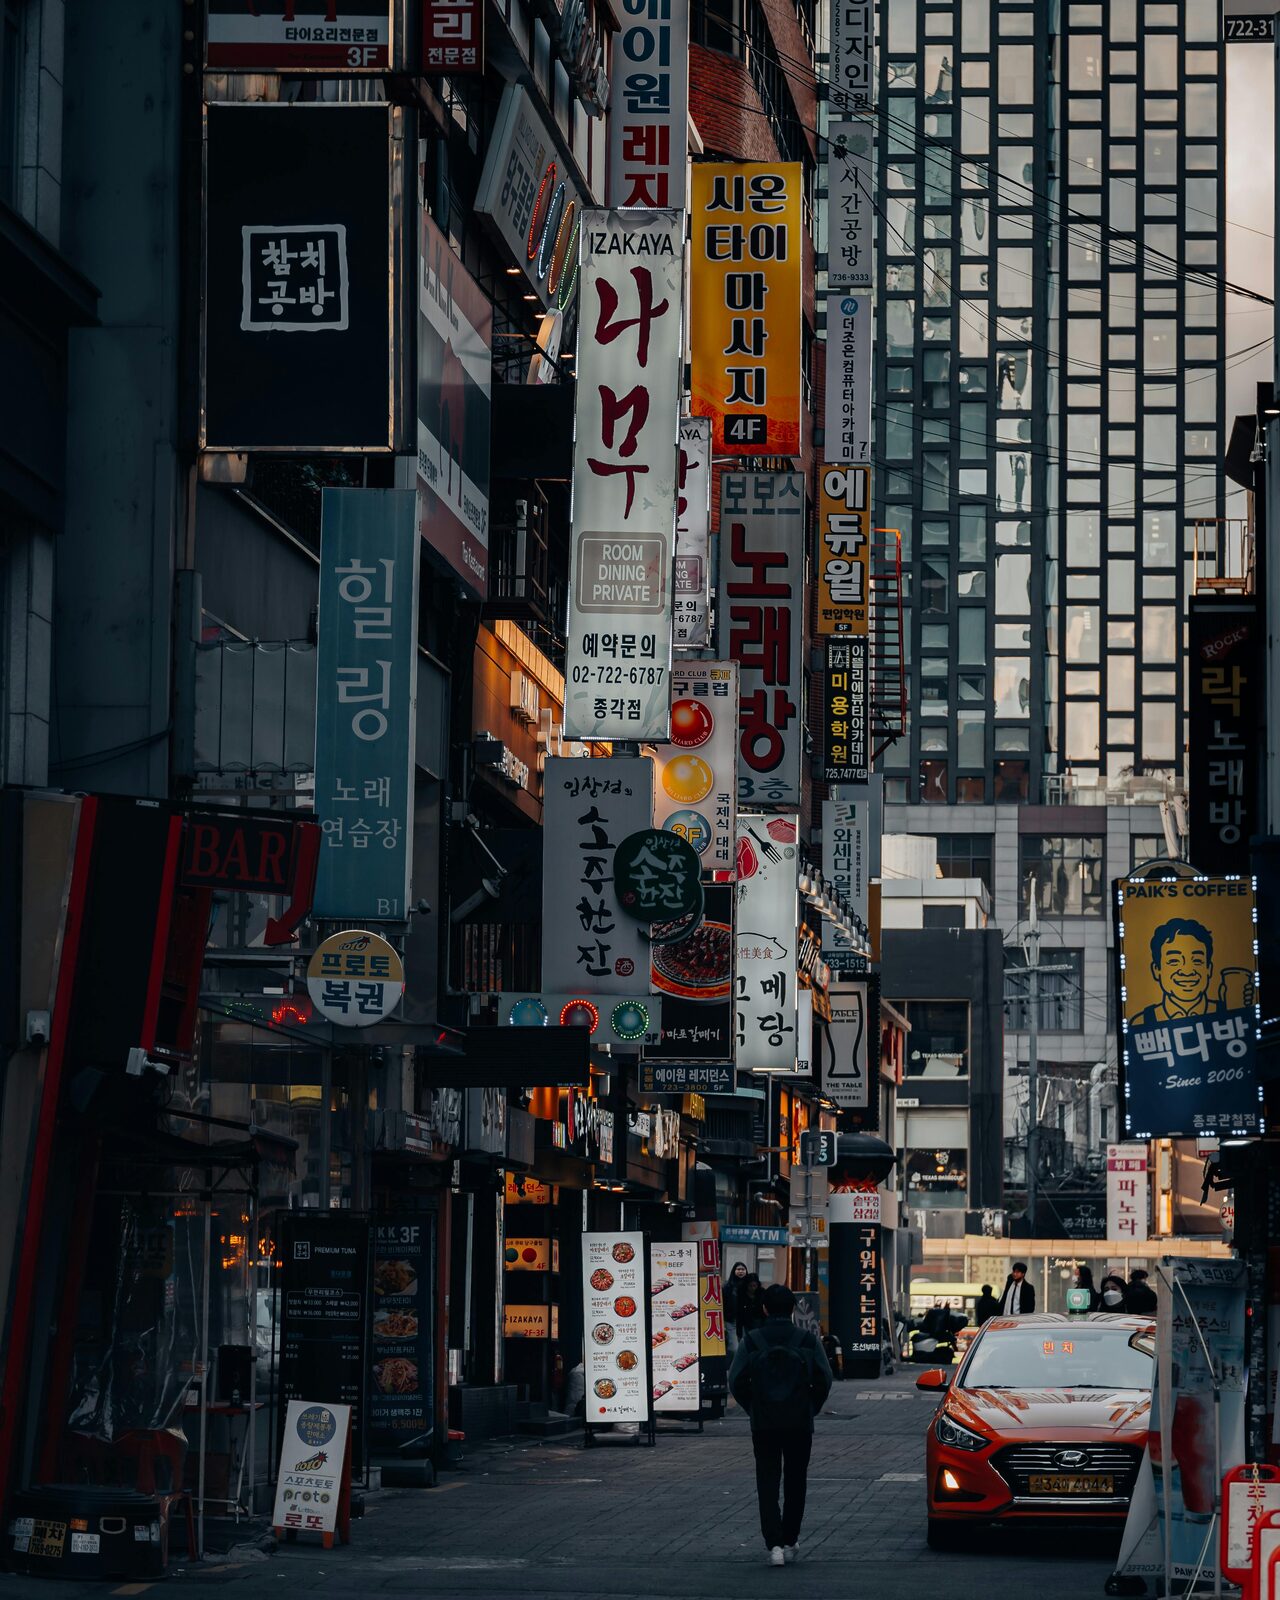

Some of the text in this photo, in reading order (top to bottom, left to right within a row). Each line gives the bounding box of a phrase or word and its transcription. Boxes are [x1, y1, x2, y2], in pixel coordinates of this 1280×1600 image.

[285, 26, 379, 43] 타이요리전문점
[346, 46, 379, 67] 3F
[427, 47, 477, 65] 전문점
[833, 92, 869, 111] 학원
[705, 174, 788, 214] 시온
[840, 166, 862, 267] 시간공방
[590, 232, 675, 256] IZAKAYA
[705, 223, 788, 262] 타이
[261, 238, 325, 277] 참치
[257, 277, 336, 317] 공방
[724, 271, 769, 407] 마사지
[730, 419, 761, 440] 4F
[724, 475, 801, 516] 보보스
[823, 468, 868, 605] 에듀윌
[602, 544, 644, 562] ROOM
[598, 564, 646, 582] DINING
[593, 583, 651, 602] PRIVATE
[821, 608, 865, 621] 편입학원
[334, 557, 396, 742] 힐링
[582, 633, 657, 659] 예약문의
[726, 522, 797, 774] 노래방
[1202, 631, 1242, 659] ROCK
[572, 665, 664, 686] 02-722-6787
[687, 669, 707, 677] CLUB
[1201, 665, 1248, 717] 락
[593, 697, 642, 720] 종각점
[830, 671, 849, 765] 미용학원
[331, 776, 392, 808] 노래
[736, 776, 794, 800] 3층
[1207, 719, 1248, 845] 노래방
[321, 816, 402, 850] 연습장
[671, 823, 702, 844] 3F
[716, 793, 731, 861] 국제식 대대
[186, 823, 287, 886] BAR
[833, 828, 853, 872] 와세다
[628, 844, 688, 885] 소주
[576, 805, 618, 977] 소주한잔
[1126, 883, 1248, 899] PAIK'S COFFEE
[377, 898, 399, 916] B1
[321, 953, 390, 978] 프로토
[321, 980, 385, 1015] 복권
[645, 1033, 659, 1043] 3F
[666, 1027, 721, 1044] 마포갈매기
[1134, 1015, 1250, 1068] 빽다방
[655, 1067, 687, 1083] 에이원
[688, 1068, 730, 1083] 레지던스
[1165, 1066, 1245, 1090] Since 2006
[1192, 1113, 1257, 1128] 종로관철점
[536, 1195, 546, 1203] 5F
[1117, 1179, 1139, 1236] 파노라
[399, 1226, 420, 1244] 3F
[751, 1229, 780, 1241] ATM
[314, 1246, 340, 1254] PREMIUM
[536, 1262, 546, 1270] 4F
[701, 1238, 725, 1341] 마사지
[509, 1315, 543, 1323] IZAKAYA
[523, 1329, 545, 1337] 2F-3F
[284, 1475, 335, 1490] 스포츠토토
[283, 1490, 331, 1504] proto
[284, 1513, 325, 1530] 로또
